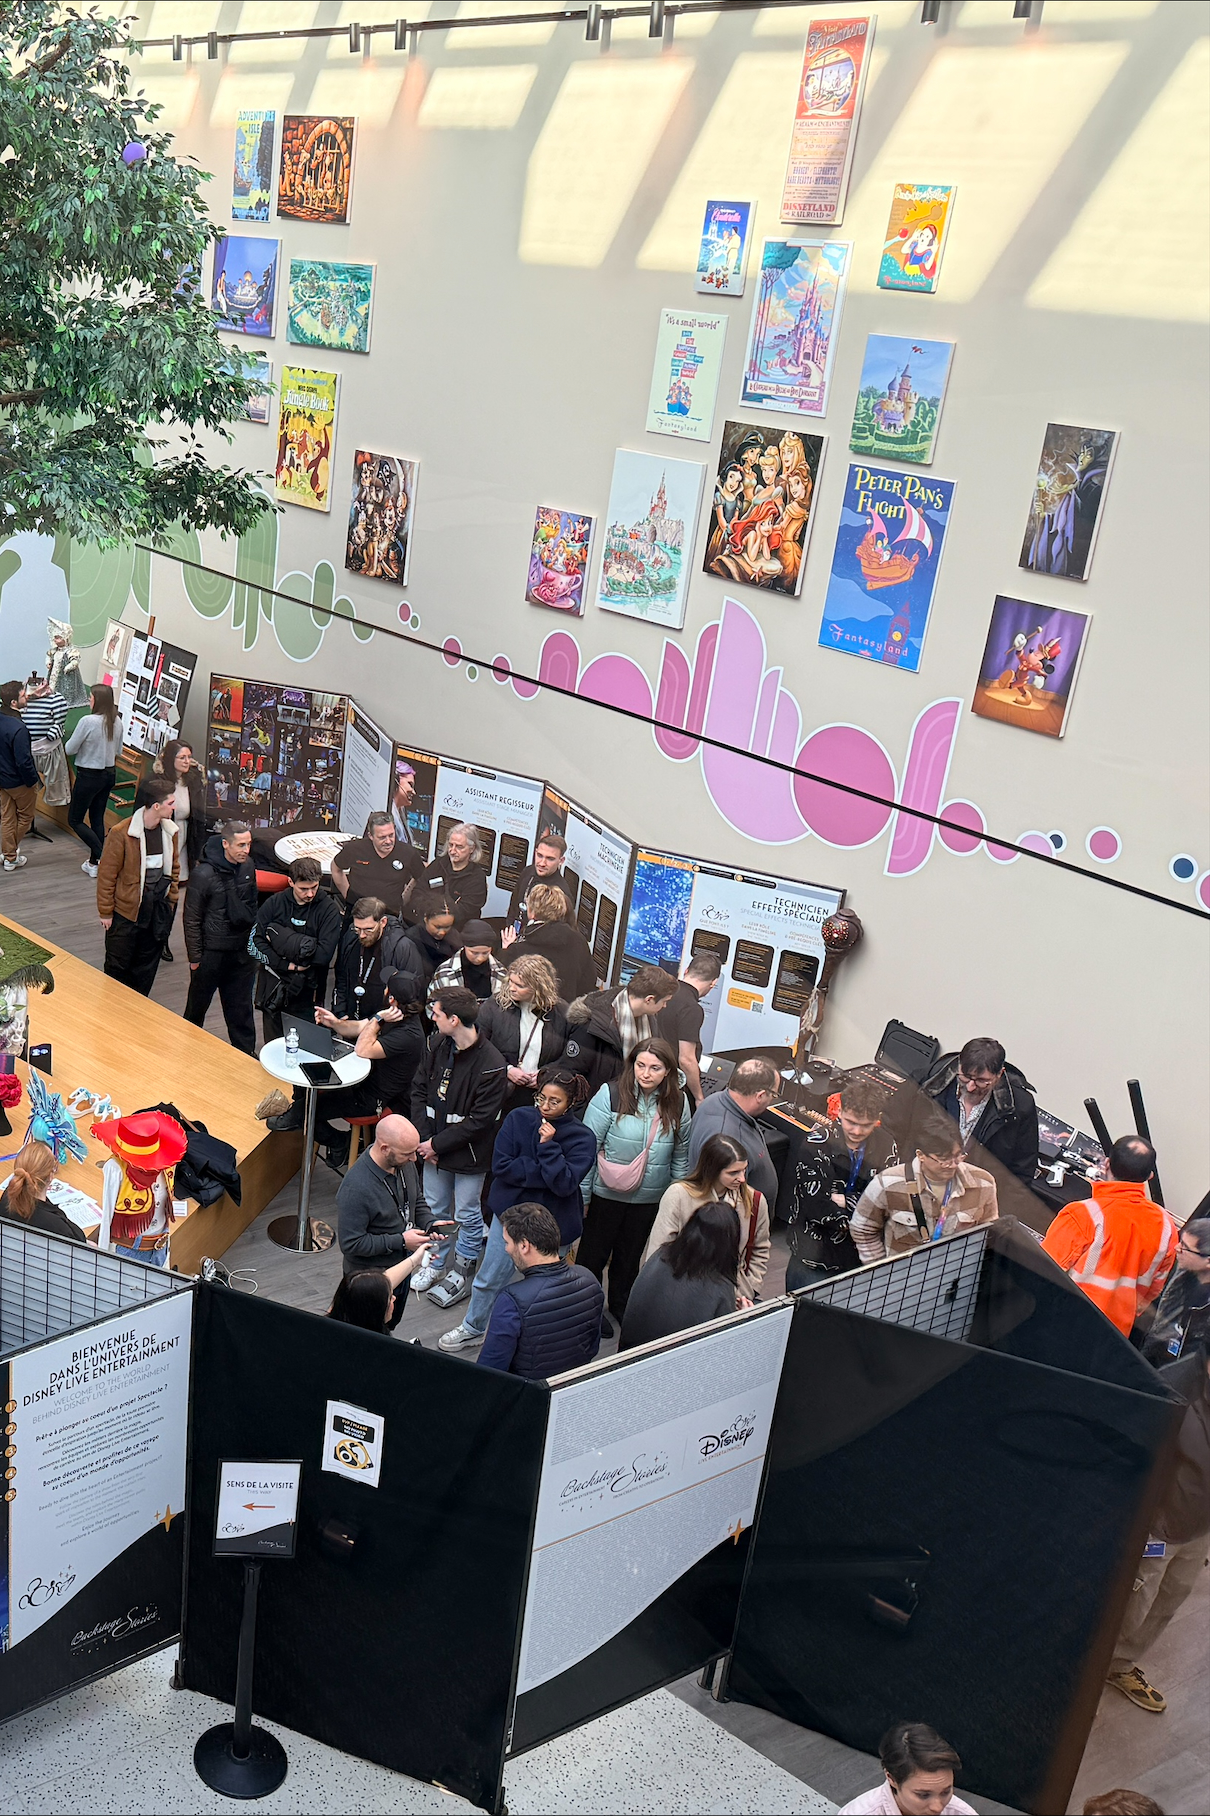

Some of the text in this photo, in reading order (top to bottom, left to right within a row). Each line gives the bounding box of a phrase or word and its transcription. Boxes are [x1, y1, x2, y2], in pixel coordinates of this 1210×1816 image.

[238, 111, 275, 121] ADVENTURE
[249, 124, 260, 134] ISLE
[783, 203, 835, 211] DISNEYLAND
[680, 319, 696, 327] small
[284, 390, 329, 411] Jungle Book
[854, 467, 944, 510] PETER PAN'S
[857, 491, 906, 519] FLIGHT
[829, 623, 909, 657] Fantasyland
[465, 788, 498, 801] ASSISTANT
[597, 851, 623, 874] MACHINERIE
[600, 843, 625, 865] TECHNICIEN
[752, 901, 782, 916] EFFETS
[774, 897, 829, 916] TECHNICIEN
[741, 907, 820, 931] SPECIAL EFFECTS TECHNICIA
[72, 1329, 136, 1362] BIENVENUE
[50, 1333, 157, 1384] DANS L'UNIVERS DE
[23, 1336, 180, 1406] DISNEY LIVE ENTERTAINMENT
[33, 1364, 170, 1424] BEHIND DISNEY LIVE ENTERTAINMENT
[54, 1364, 151, 1406] WELCOME TO THE WORLD
[59, 1421, 81, 1434] plonger
[90, 1411, 106, 1420] coeur
[107, 1405, 118, 1413] d'un
[120, 1399, 136, 1411] projet
[138, 1388, 163, 1402] Spectacle
[67, 1430, 85, 1441] parcours
[138, 1401, 155, 1411] première
[68, 1449, 83, 1460] équipes
[97, 1444, 110, 1455] Disney
[112, 1440, 121, 1448] Live
[43, 1476, 61, 1487] Bonne
[63, 1462, 94, 1479] découverte
[141, 1434, 159, 1447] voyage
[60, 1478, 76, 1487] coeur
[77, 1472, 89, 1480] d'un
[90, 1464, 109, 1475] monde
[561, 1454, 667, 1497] Backstage Stories
[71, 1617, 122, 1645] Backstage
[112, 1607, 157, 1637] Stories
